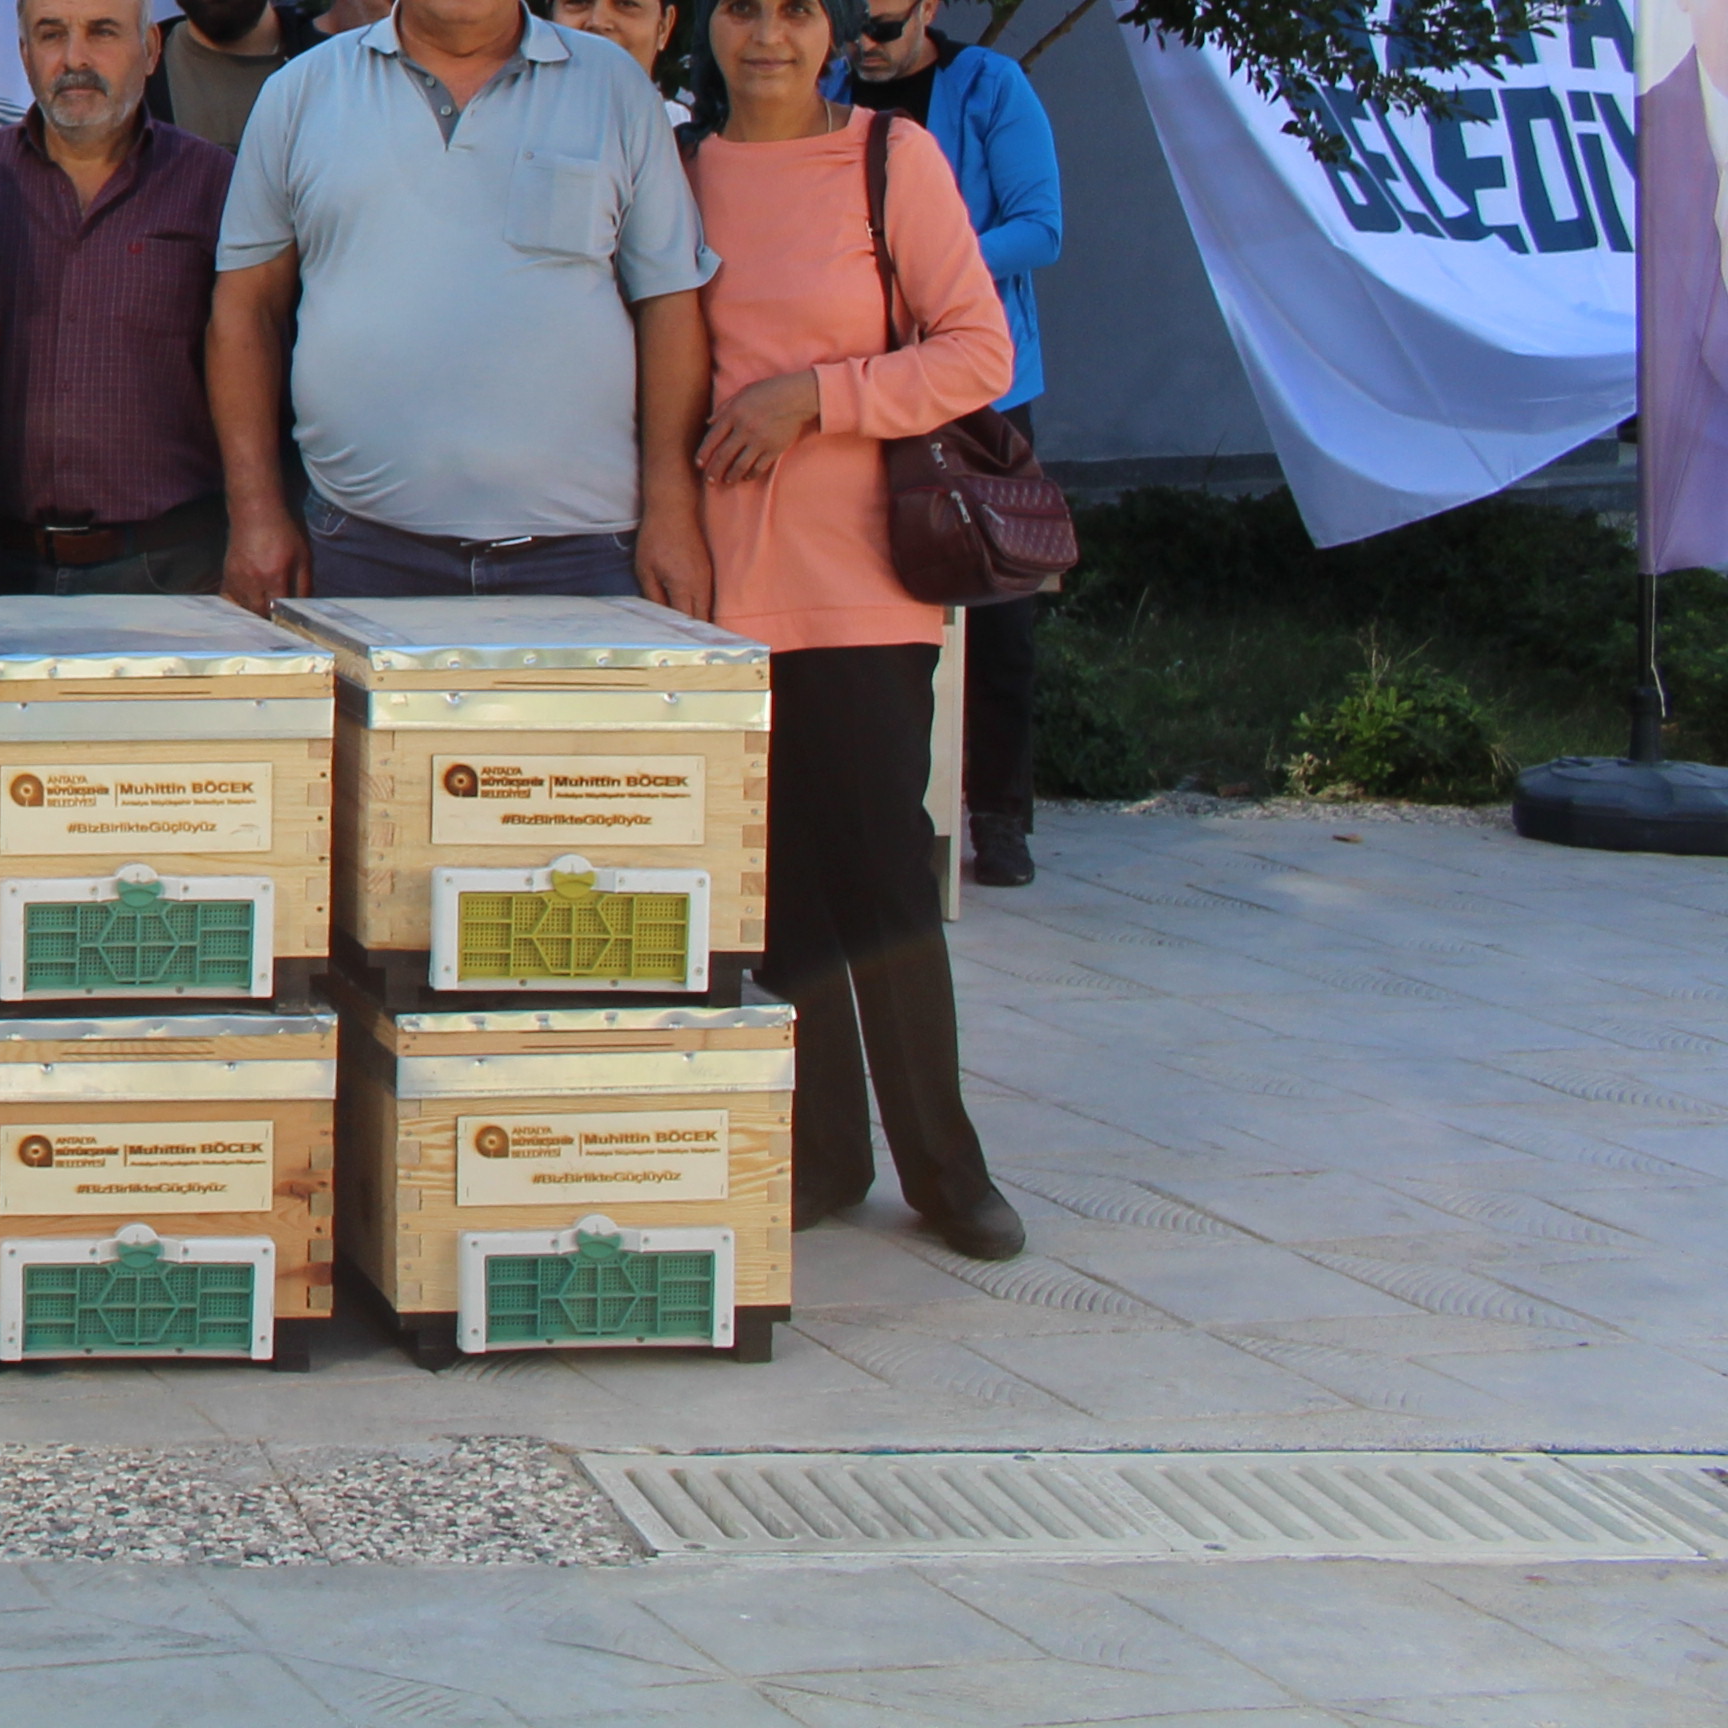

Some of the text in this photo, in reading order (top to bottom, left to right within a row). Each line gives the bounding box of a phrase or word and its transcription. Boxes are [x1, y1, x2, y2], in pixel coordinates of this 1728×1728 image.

[119, 779, 254, 795] Muhittin BÖCEK
[554, 773, 689, 787] Muhittin BÖCEK
[68, 820, 218, 834] #BizBirlikteGüçlüyüz
[502, 813, 652, 828] #BizBirlikteGüçlüyüz
[584, 1128, 718, 1145] Muhittin BÖCEK
[128, 1140, 264, 1156] Muhittin BÖCEK
[533, 1169, 682, 1185] #BizBirlikteGüçlüyüz
[77, 1181, 227, 1195] #BizBirlikteGüçlüyüz
